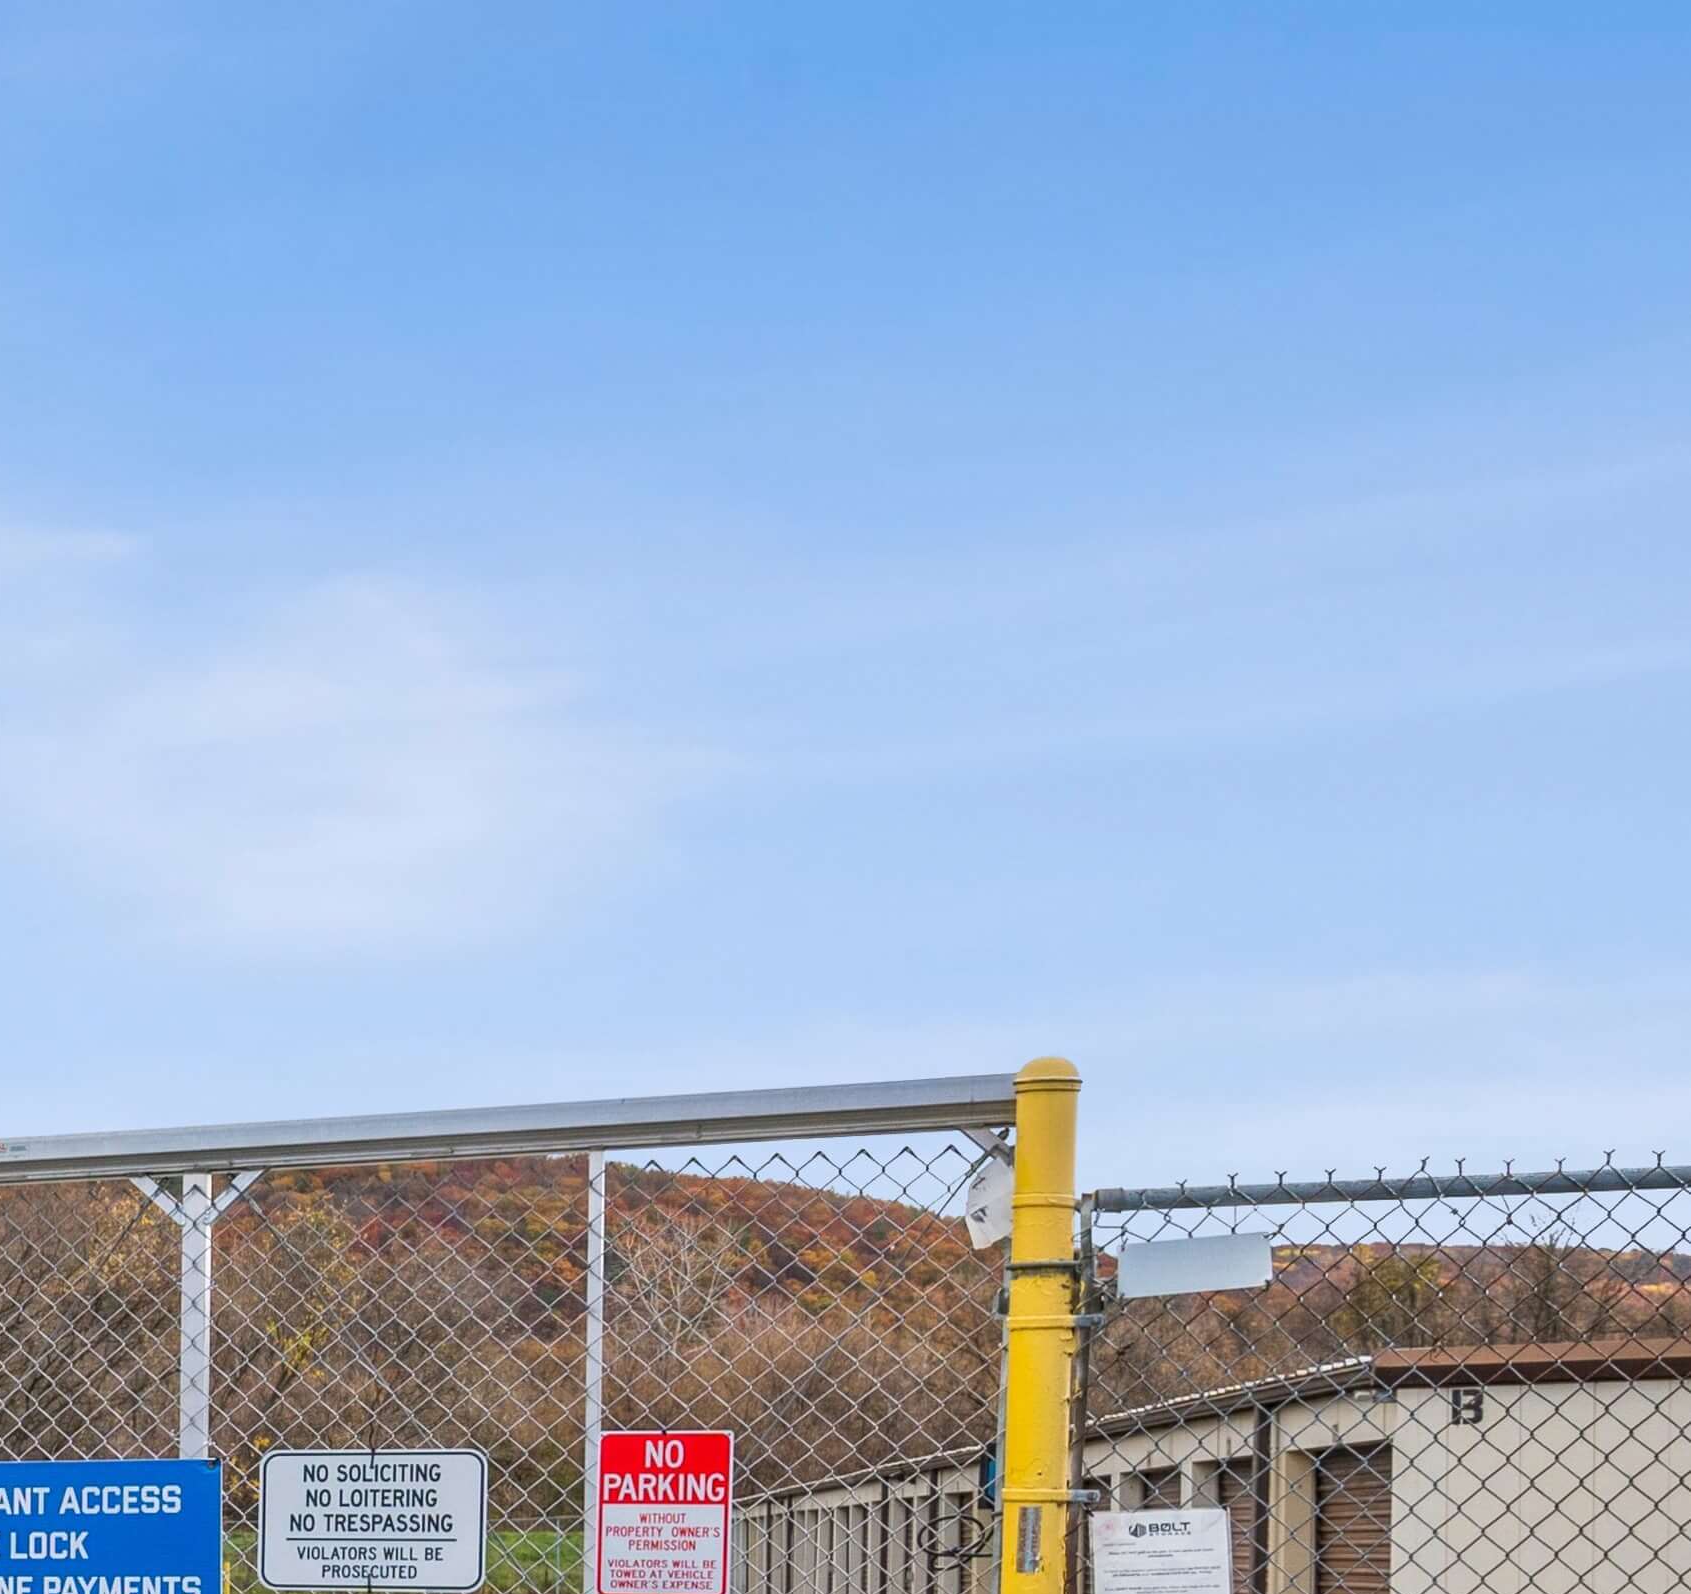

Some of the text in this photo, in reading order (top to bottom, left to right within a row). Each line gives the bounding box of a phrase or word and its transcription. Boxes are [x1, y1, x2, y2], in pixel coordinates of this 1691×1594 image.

[1452, 1389, 1483, 1425] B
[645, 1439, 684, 1469] NO
[303, 1464, 441, 1482] NO SOLICITING
[603, 1473, 725, 1501] PARKING
[59, 1485, 182, 1515] ACCESS
[305, 1489, 438, 1507] NO LOITERING
[290, 1514, 453, 1533] NO TRESPASSING
[639, 1513, 686, 1524] WITHOUT
[605, 1527, 720, 1538] PROPERTY OWNER'S
[10, 1531, 90, 1560] LOCK
[297, 1546, 444, 1561] VIOLATORS WILL BE
[628, 1540, 696, 1551] PERMISSION
[321, 1565, 418, 1579] PROSECUTED
[607, 1559, 717, 1569] VIOLATORS WILL BE
[610, 1570, 713, 1580] TOWED AT VEHICLE
[610, 1579, 713, 1590] OWNER'S EXPENSE
